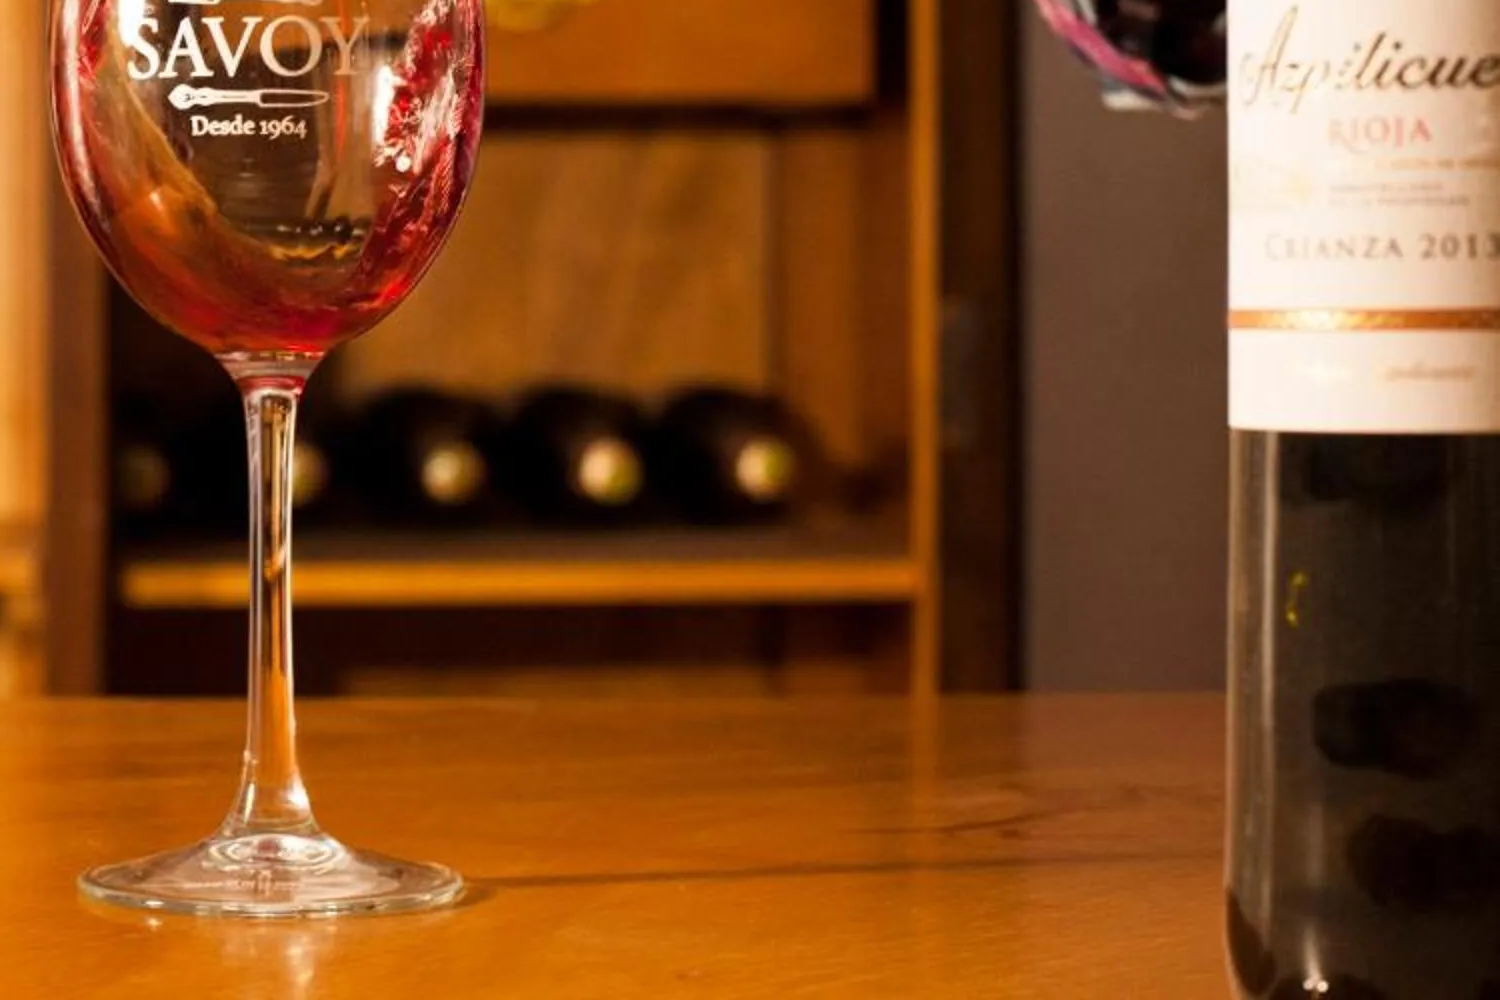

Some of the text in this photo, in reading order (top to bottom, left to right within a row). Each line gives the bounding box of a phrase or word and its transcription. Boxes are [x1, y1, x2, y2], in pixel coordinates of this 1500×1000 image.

[127, 14, 370, 80] SAVOY
[191, 114, 307, 139] Desde 1964
